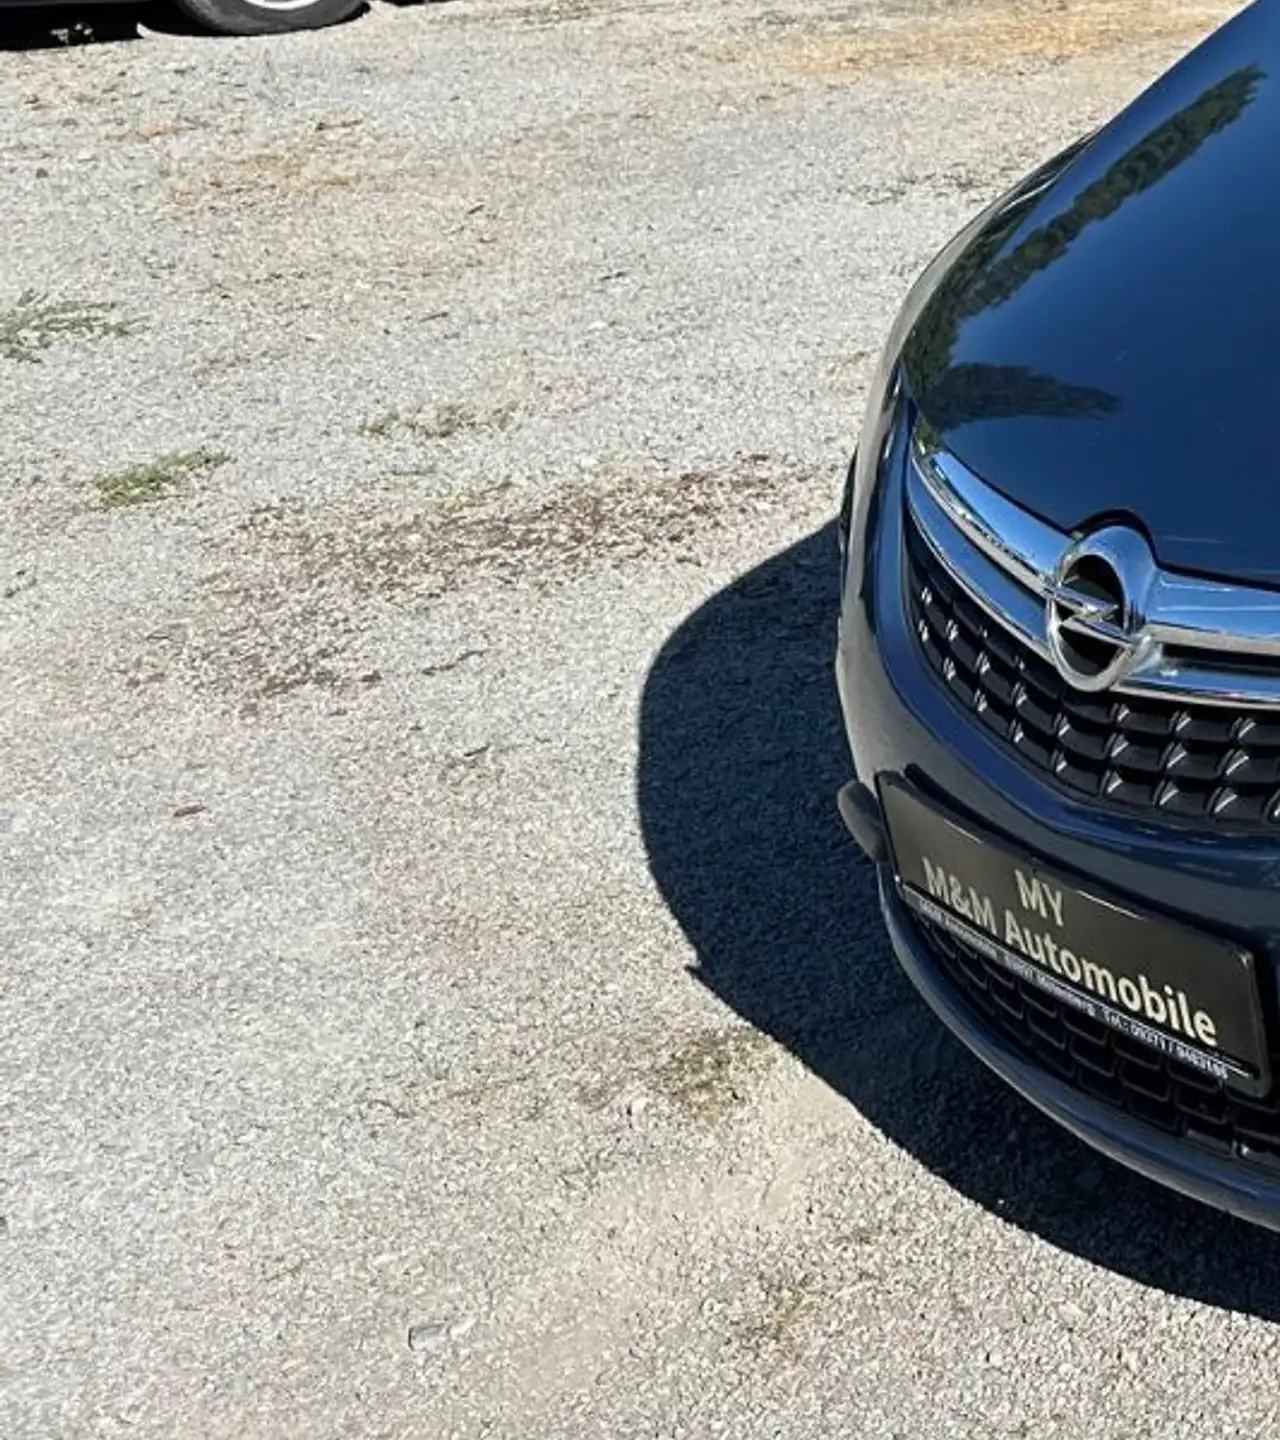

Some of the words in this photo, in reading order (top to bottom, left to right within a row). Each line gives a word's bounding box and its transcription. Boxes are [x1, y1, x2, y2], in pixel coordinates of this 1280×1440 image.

[921, 855, 998, 936] M&M
[1004, 908, 1219, 1047] Automobile
[1014, 868, 1064, 927] MY
